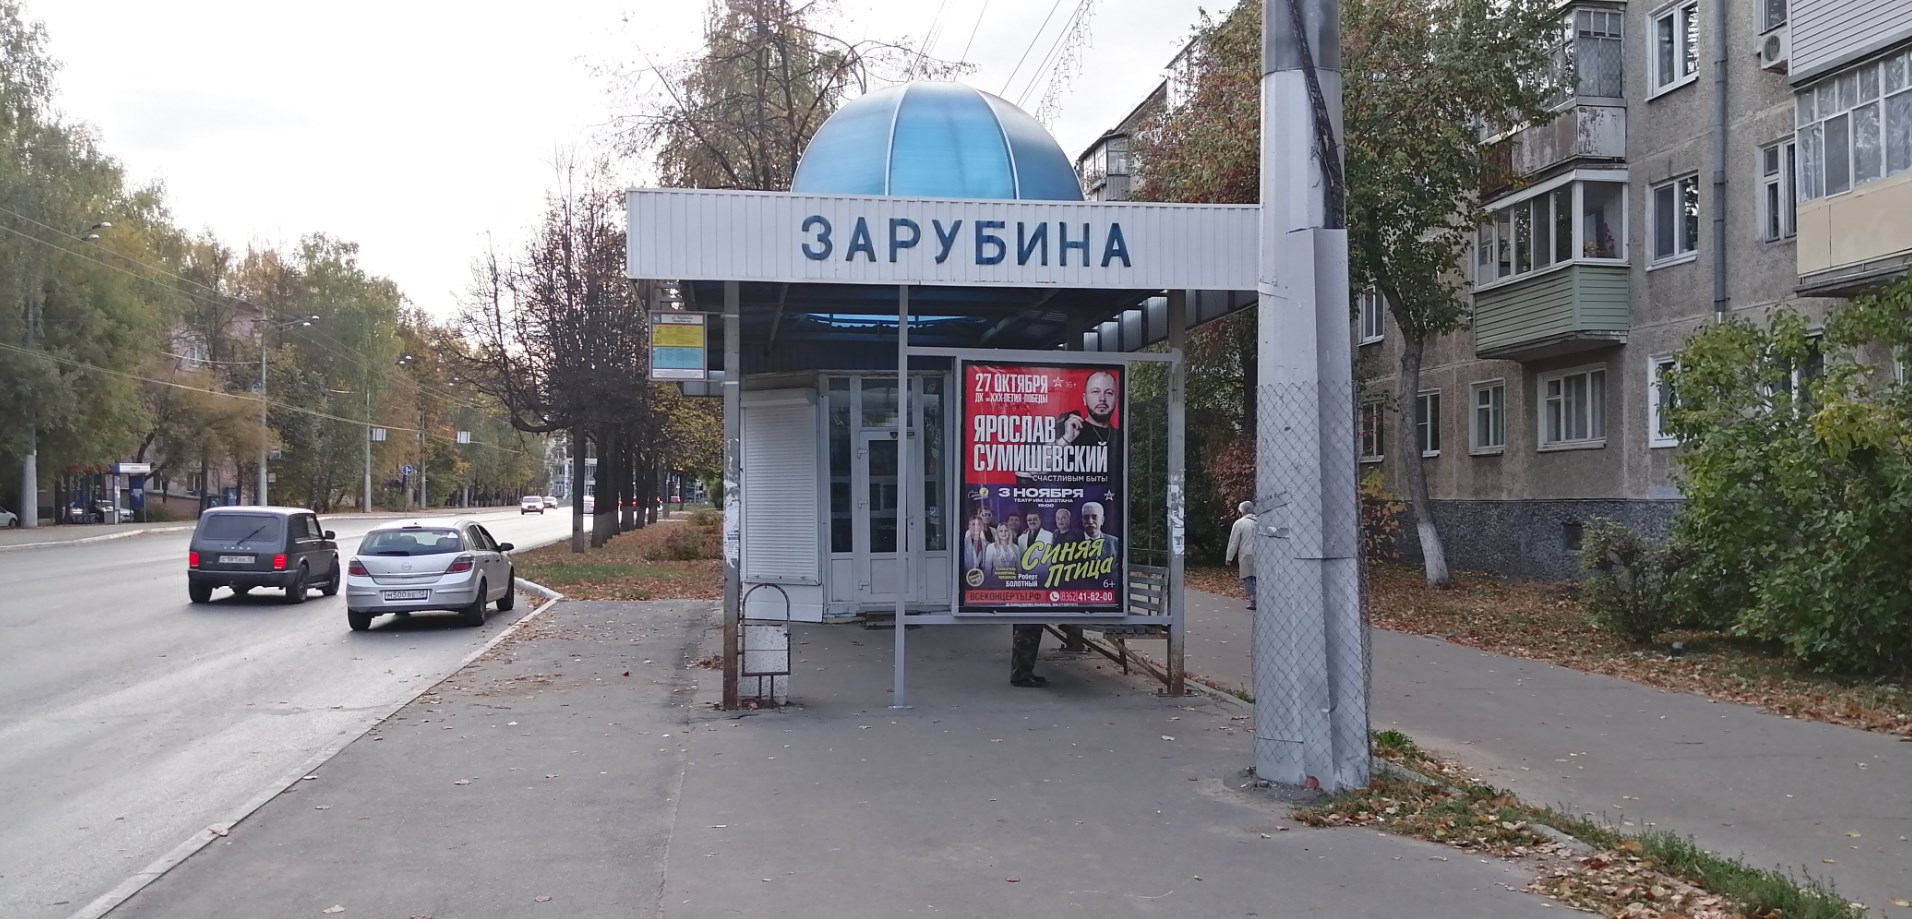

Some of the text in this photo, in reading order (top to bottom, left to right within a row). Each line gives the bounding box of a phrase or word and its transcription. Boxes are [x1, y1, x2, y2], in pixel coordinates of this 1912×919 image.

[801, 215, 1132, 268] ЗАРУБИНА
[975, 373, 1048, 393] 27 ОКТЯБРЯ
[975, 392, 984, 403] ДК
[1023, 393, 1048, 404] ПОБЕДЫ
[973, 415, 1056, 443] ЯРОСЛАВ
[973, 441, 1108, 473] СУМИШЕВСКИЙ
[998, 487, 1010, 498] 3
[1013, 487, 1084, 498] НОЯБРЯ
[1018, 573, 1038, 581] Роберт
[1102, 580, 1116, 588] 6+
[969, 591, 1042, 602] ВСЕКОНЦЕРТЫ.РФ
[1078, 591, 1113, 601] 41-62-00
